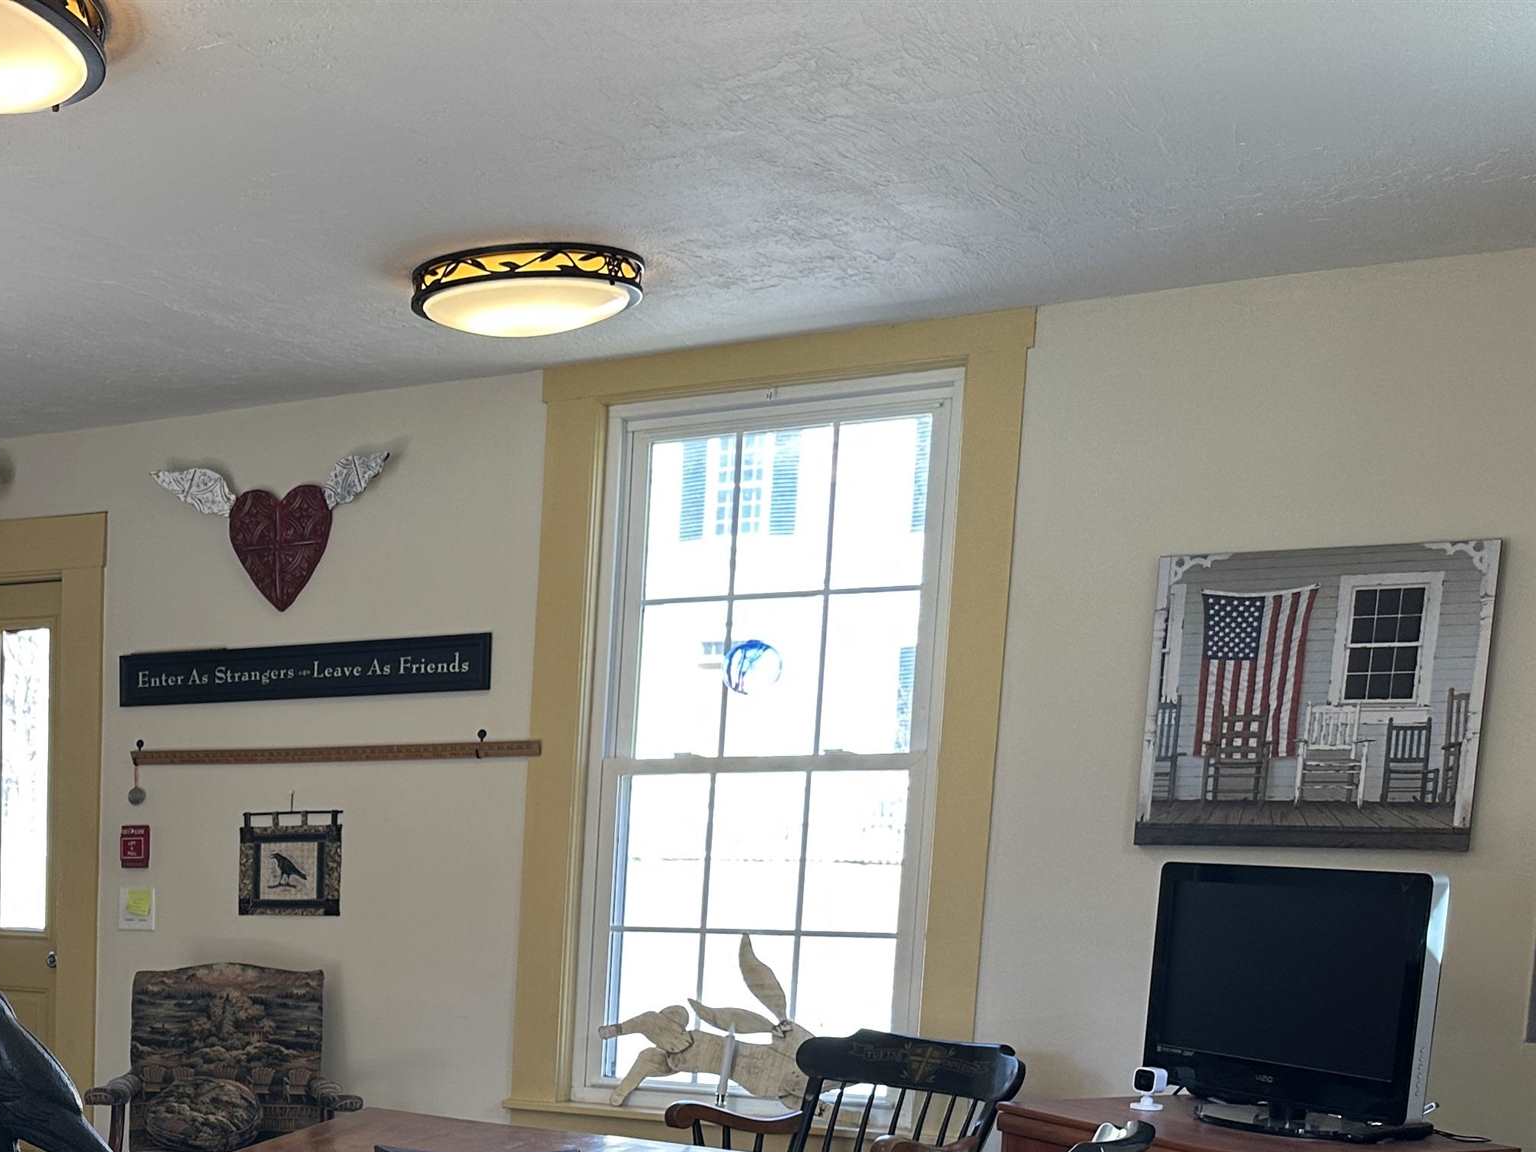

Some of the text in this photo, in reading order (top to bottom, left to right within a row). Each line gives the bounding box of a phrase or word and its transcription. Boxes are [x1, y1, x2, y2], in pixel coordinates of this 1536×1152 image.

[137, 652, 470, 689] Enter As Strangers Leave As Friends
